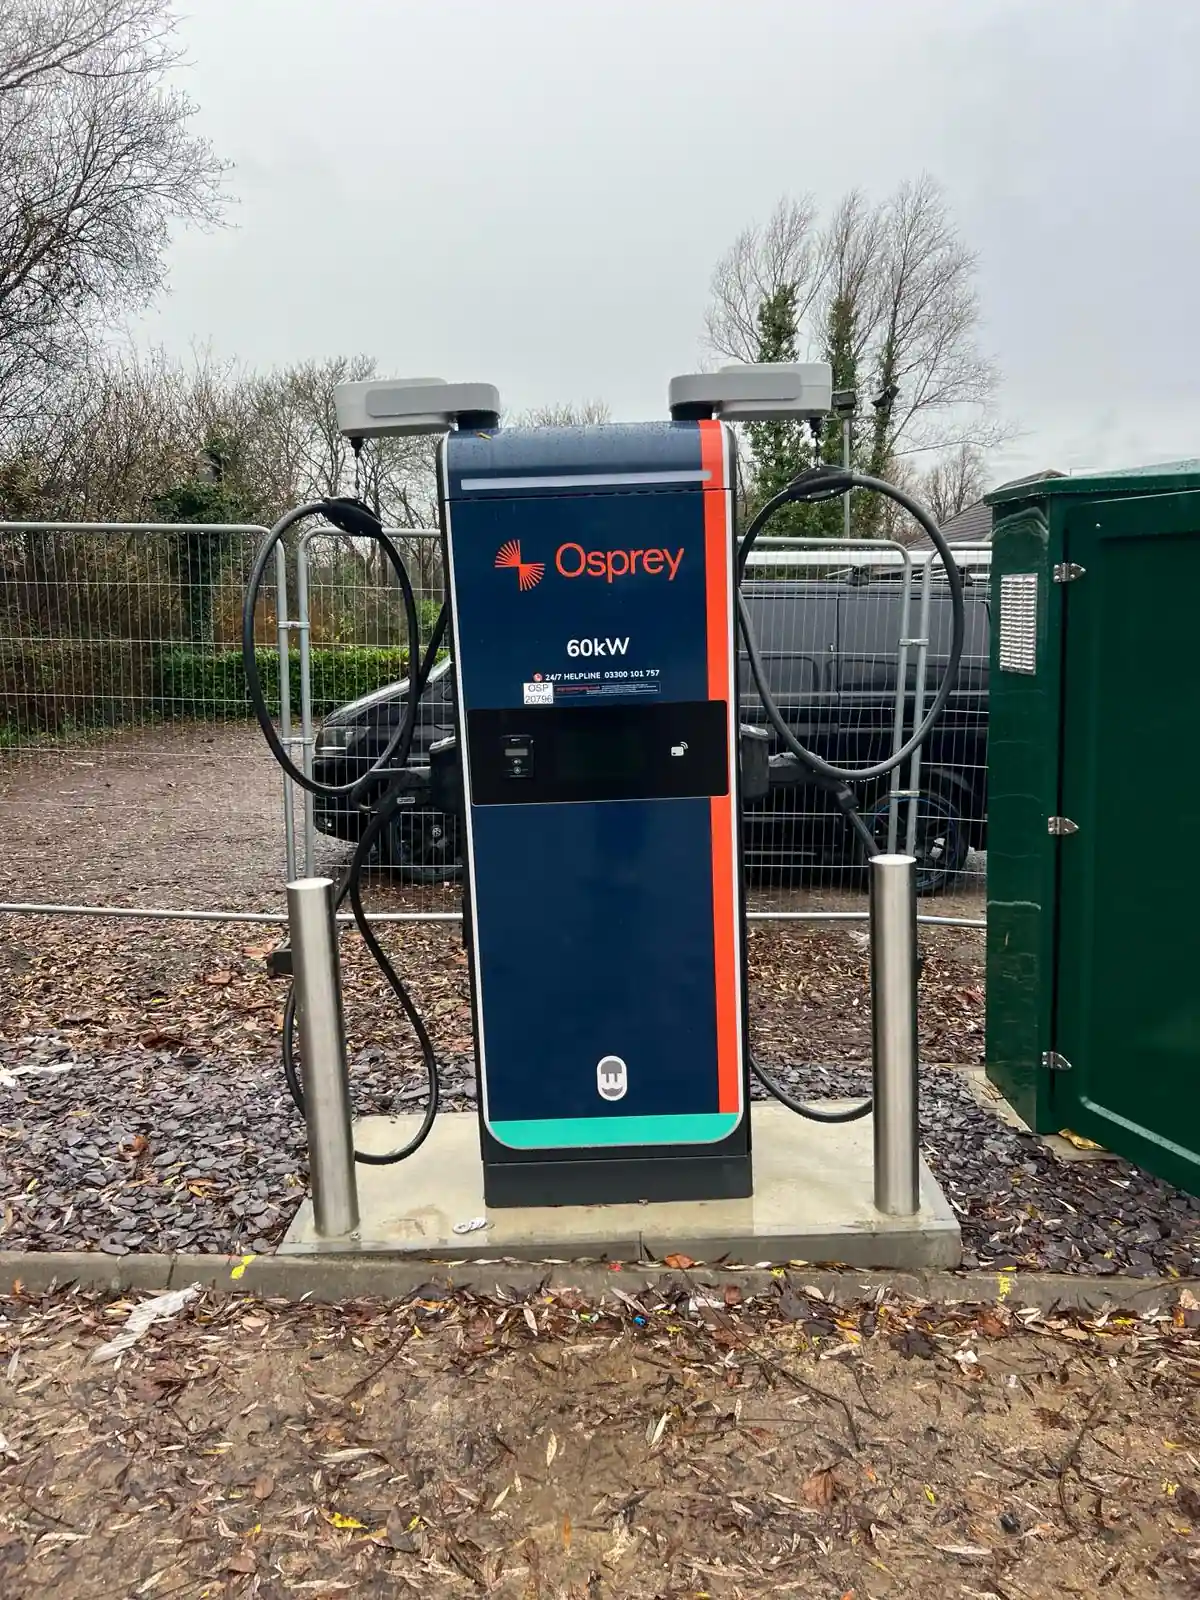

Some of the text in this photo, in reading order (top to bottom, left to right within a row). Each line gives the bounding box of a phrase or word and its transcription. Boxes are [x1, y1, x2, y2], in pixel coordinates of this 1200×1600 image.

[555, 542, 685, 584] Osprey
[566, 637, 630, 657] 60kW
[545, 669, 660, 681] 24/7 HELPLINE 03300 101 757
[527, 684, 549, 693] OSP
[525, 695, 553, 704] 20796
